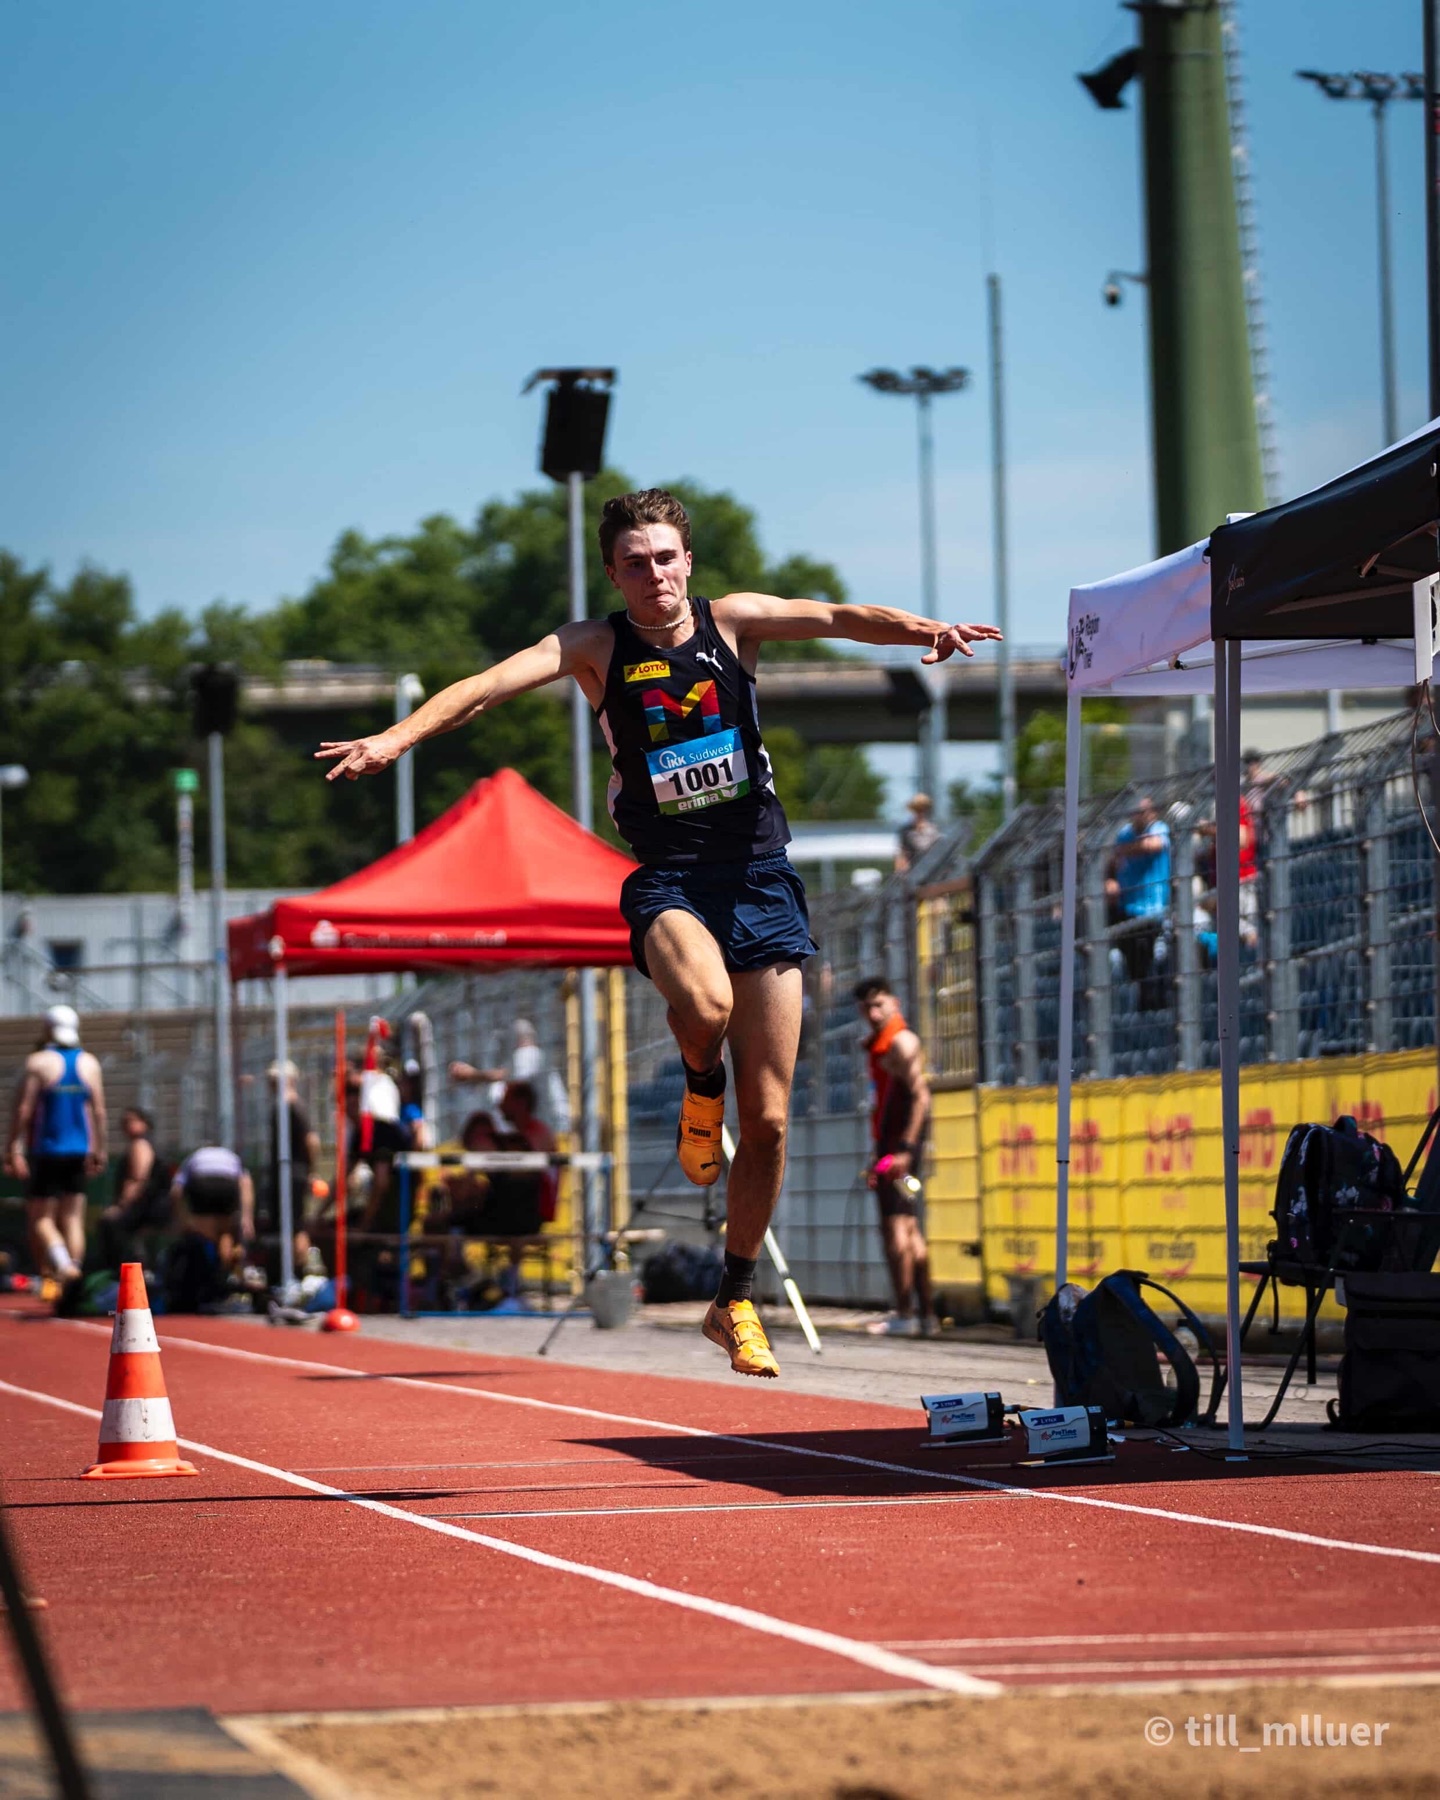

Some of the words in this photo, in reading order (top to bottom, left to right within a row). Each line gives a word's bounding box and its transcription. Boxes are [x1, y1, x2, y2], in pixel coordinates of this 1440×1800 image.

[638, 663, 667, 674] LOTTO
[668, 758, 734, 796] 1001
[677, 792, 722, 811] erima
[688, 1125, 712, 1139] PUMA
